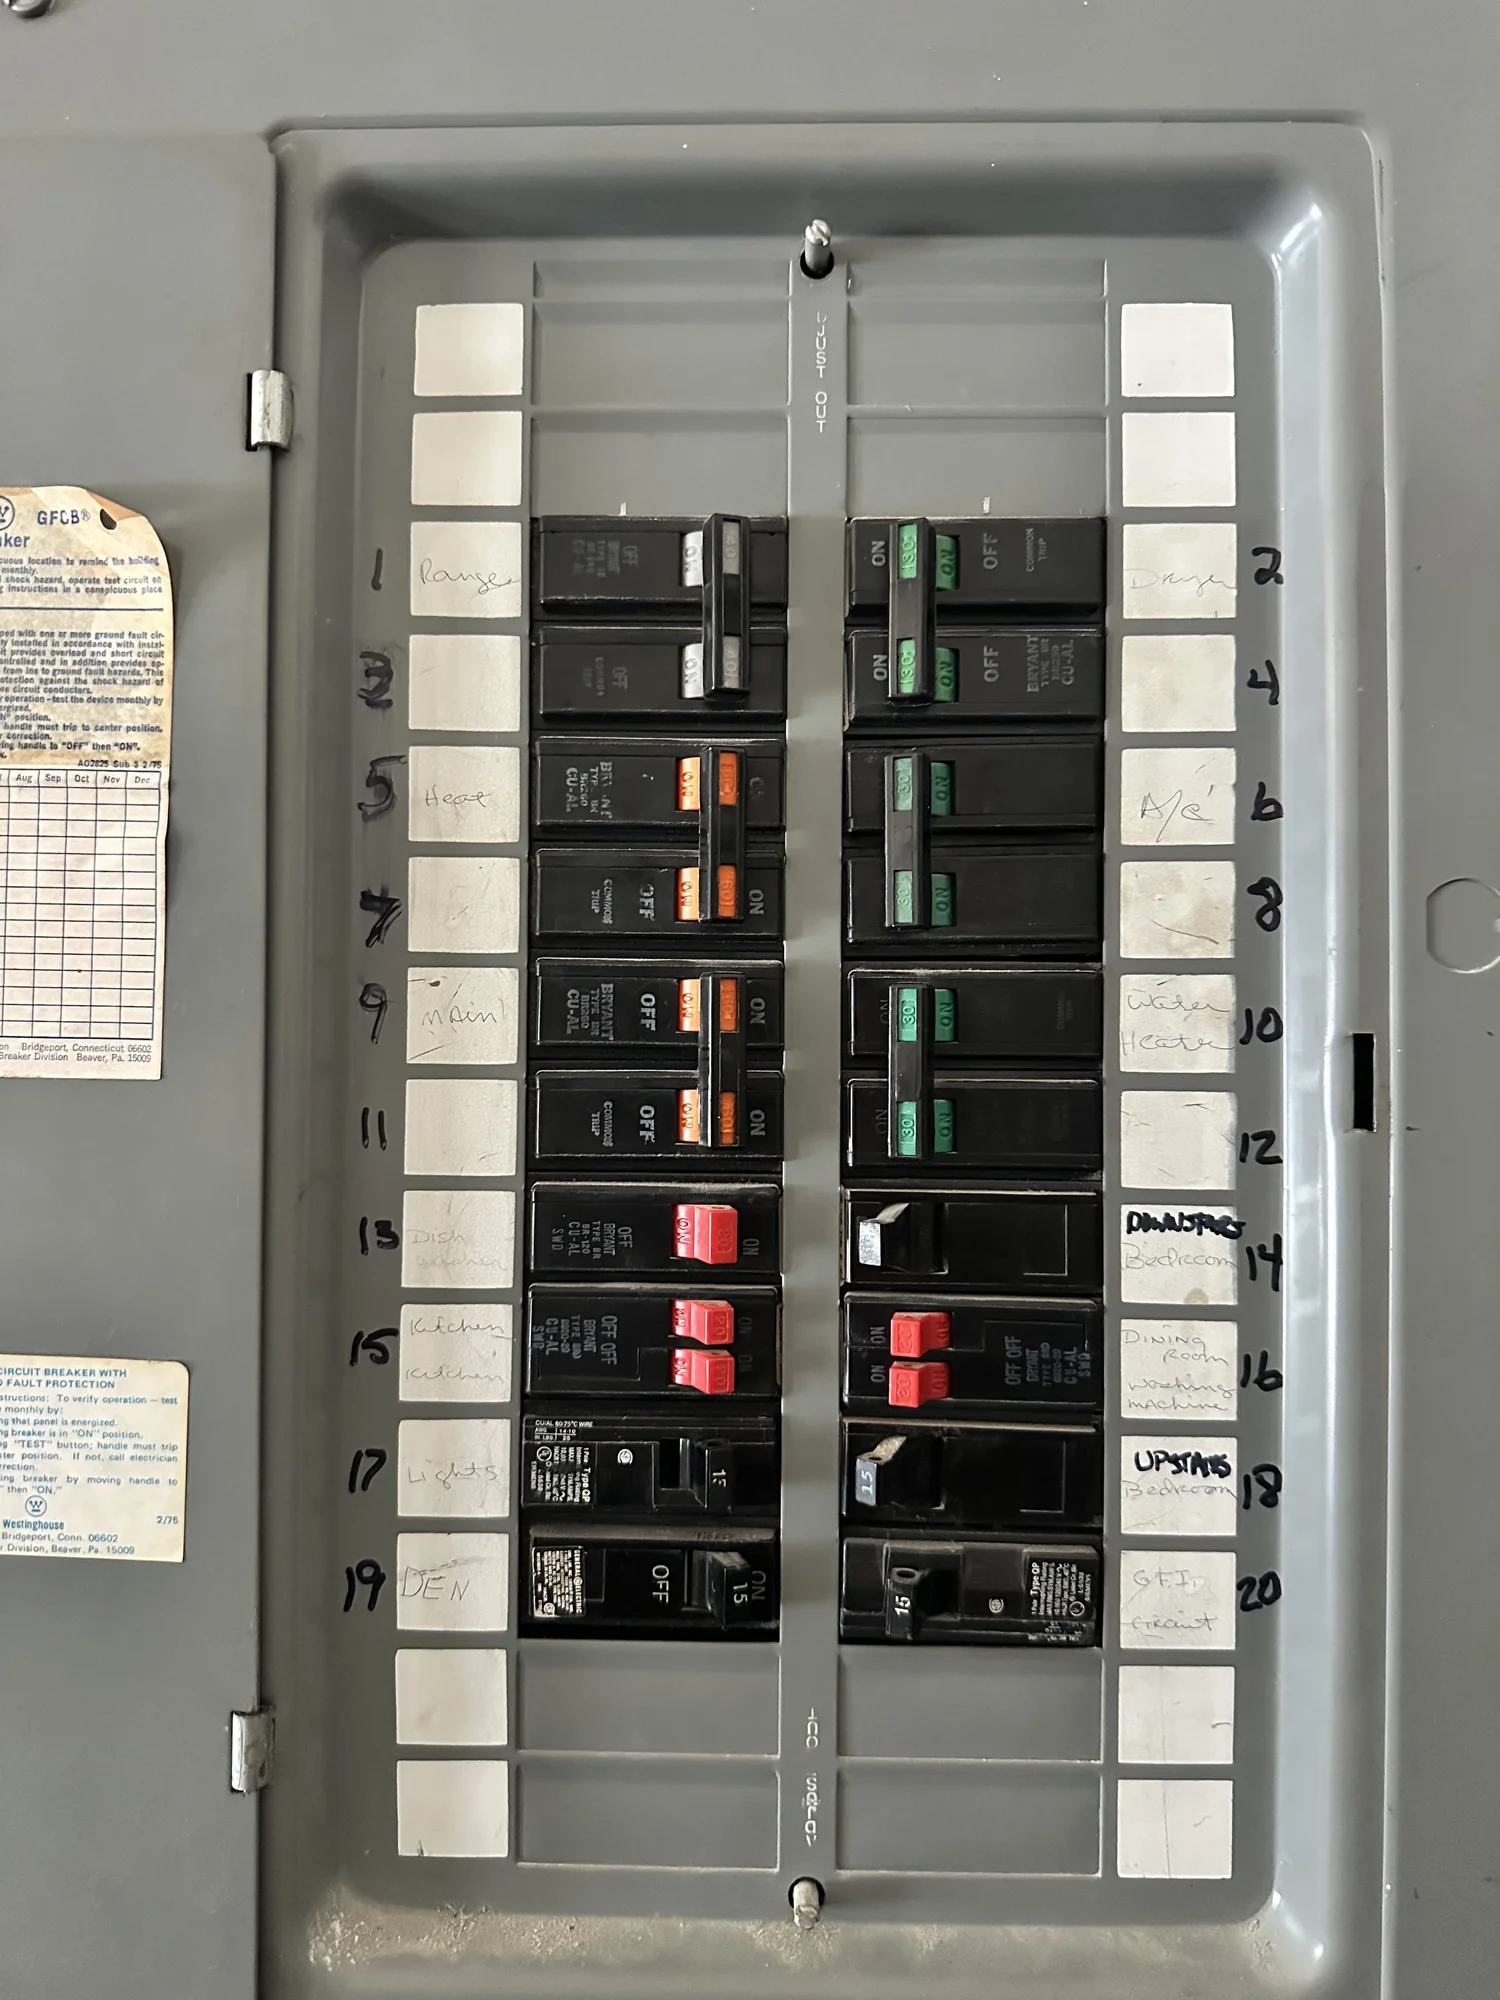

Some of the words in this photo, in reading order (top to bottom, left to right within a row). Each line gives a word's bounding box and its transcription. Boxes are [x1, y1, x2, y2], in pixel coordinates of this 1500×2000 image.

[815, 391, 827, 433] OUT
[871, 540, 886, 567] ON
[940, 548, 955, 576] ON
[982, 532, 998, 570] OFF
[1038, 537, 1047, 562] TRIP
[1251, 546, 1285, 586] 2
[873, 654, 888, 682] ON
[940, 661, 954, 688] ON
[983, 645, 999, 682] OFF
[1026, 634, 1040, 692] BRYANT
[1246, 659, 1280, 706] 4
[16, 774, 32, 783] Aug
[45, 774, 61, 783] Sep
[74, 775, 89, 783] Oct
[104, 776, 120, 784] Nov
[135, 776, 150, 784] Dec
[683, 770, 694, 796] ON
[936, 776, 949, 802] ON
[682, 882, 692, 907] ON
[748, 889, 764, 915] ON
[936, 887, 949, 912] ON
[1246, 876, 1284, 933] 8
[358, 981, 389, 1044] 9
[566, 988, 580, 1035] CU-AL
[591, 988, 600, 1016] TYPE
[640, 992, 656, 1032] OFF
[682, 992, 694, 1018] ON
[750, 997, 766, 1024] ON
[902, 1004, 916, 1024] 30
[940, 1002, 952, 1028] ON
[1238, 1006, 1284, 1046] 10
[22, 1043, 68, 1053] Bridgeport,
[72, 1043, 124, 1053] Connecticut
[128, 1044, 151, 1053] 06602
[34, 1053, 68, 1061] Division
[77, 1053, 108, 1063] Beaver,
[112, 1054, 125, 1062] Pa.
[128, 1054, 151, 1062] 15009
[592, 1111, 600, 1136] TRIP
[639, 1104, 655, 1145] OFF
[682, 1103, 693, 1128] ON
[750, 1109, 766, 1136] ON
[902, 1118, 914, 1138] 30
[940, 1112, 952, 1138] ON
[361, 1106, 388, 1151] 11
[1238, 1129, 1284, 1165] 12
[359, 1216, 400, 1256] 13
[568, 1220, 580, 1256] CU-AL
[582, 1223, 590, 1256] BR-120
[592, 1220, 601, 1242] TYPE
[603, 1223, 616, 1256] BRYANT
[617, 1226, 633, 1248] OFF
[676, 1217, 690, 1245] ON
[592, 1247, 601, 1260] BR
[742, 1238, 760, 1256] ON
[1245, 1232, 1284, 1292] 14
[601, 1315, 618, 1339] OFF
[714, 1316, 726, 1337] 20
[870, 1326, 886, 1345] ON
[349, 1326, 400, 1367] 15
[601, 1342, 618, 1366] OFF
[1006, 1336, 1022, 1358] OFF
[44, 1368, 95, 1377] BREAKER
[100, 1369, 126, 1377] WITH
[870, 1364, 886, 1384] ON
[1004, 1362, 1022, 1386] OFF
[1239, 1349, 1284, 1392] 16
[7, 1379, 43, 1388] FAULT
[46, 1380, 115, 1388] PROTECTION
[5, 1405, 44, 1415] monthly
[47, 1406, 63, 1416] by:
[57, 1394, 69, 1402] To
[72, 1394, 98, 1404] verify
[102, 1396, 147, 1405] operation
[161, 1396, 178, 1404] test
[12, 1417, 30, 1425] that
[34, 1418, 58, 1427] panel
[62, 1418, 68, 1426] is
[71, 1419, 118, 1428] energized.
[12, 1428, 46, 1437] breaker
[49, 1429, 56, 1437] is
[60, 1429, 68, 1437] in
[102, 1430, 143, 1440] position.
[578, 1420, 594, 1428] WIRE
[22, 1452, 62, 1462] position.
[72, 1452, 80, 1460] If
[85, 1454, 104, 1462] not,
[109, 1453, 125, 1461] call
[130, 1454, 178, 1462] electrician
[57, 1441, 93, 1450] button;
[97, 1441, 128, 1450] handle
[133, 1442, 156, 1450] must
[161, 1442, 178, 1452] trip
[23, 1474, 58, 1483] breaker
[67, 1475, 78, 1484] by
[87, 1476, 121, 1486] moving
[129, 1476, 160, 1485] handle
[169, 1477, 178, 1485] to
[349, 1448, 387, 1494] 17
[862, 1470, 874, 1495] 15
[1241, 1463, 1284, 1510] 18
[2, 1532, 54, 1542] Bridgeport,
[58, 1533, 84, 1542] Conn.
[88, 1534, 118, 1542] 06602
[3, 1519, 64, 1531] Westinghouse
[7, 1544, 48, 1554] Division,
[52, 1545, 86, 1554] Beaver,
[107, 1546, 135, 1554] 15009
[343, 1558, 387, 1613] 19
[401, 1565, 470, 1602] DEN
[652, 1564, 670, 1604] OFF
[733, 1582, 748, 1604] 15
[751, 1570, 766, 1600] ON
[1030, 1575, 1040, 1596] Type
[1236, 1570, 1283, 1613] 20
[894, 1596, 911, 1616] 15
